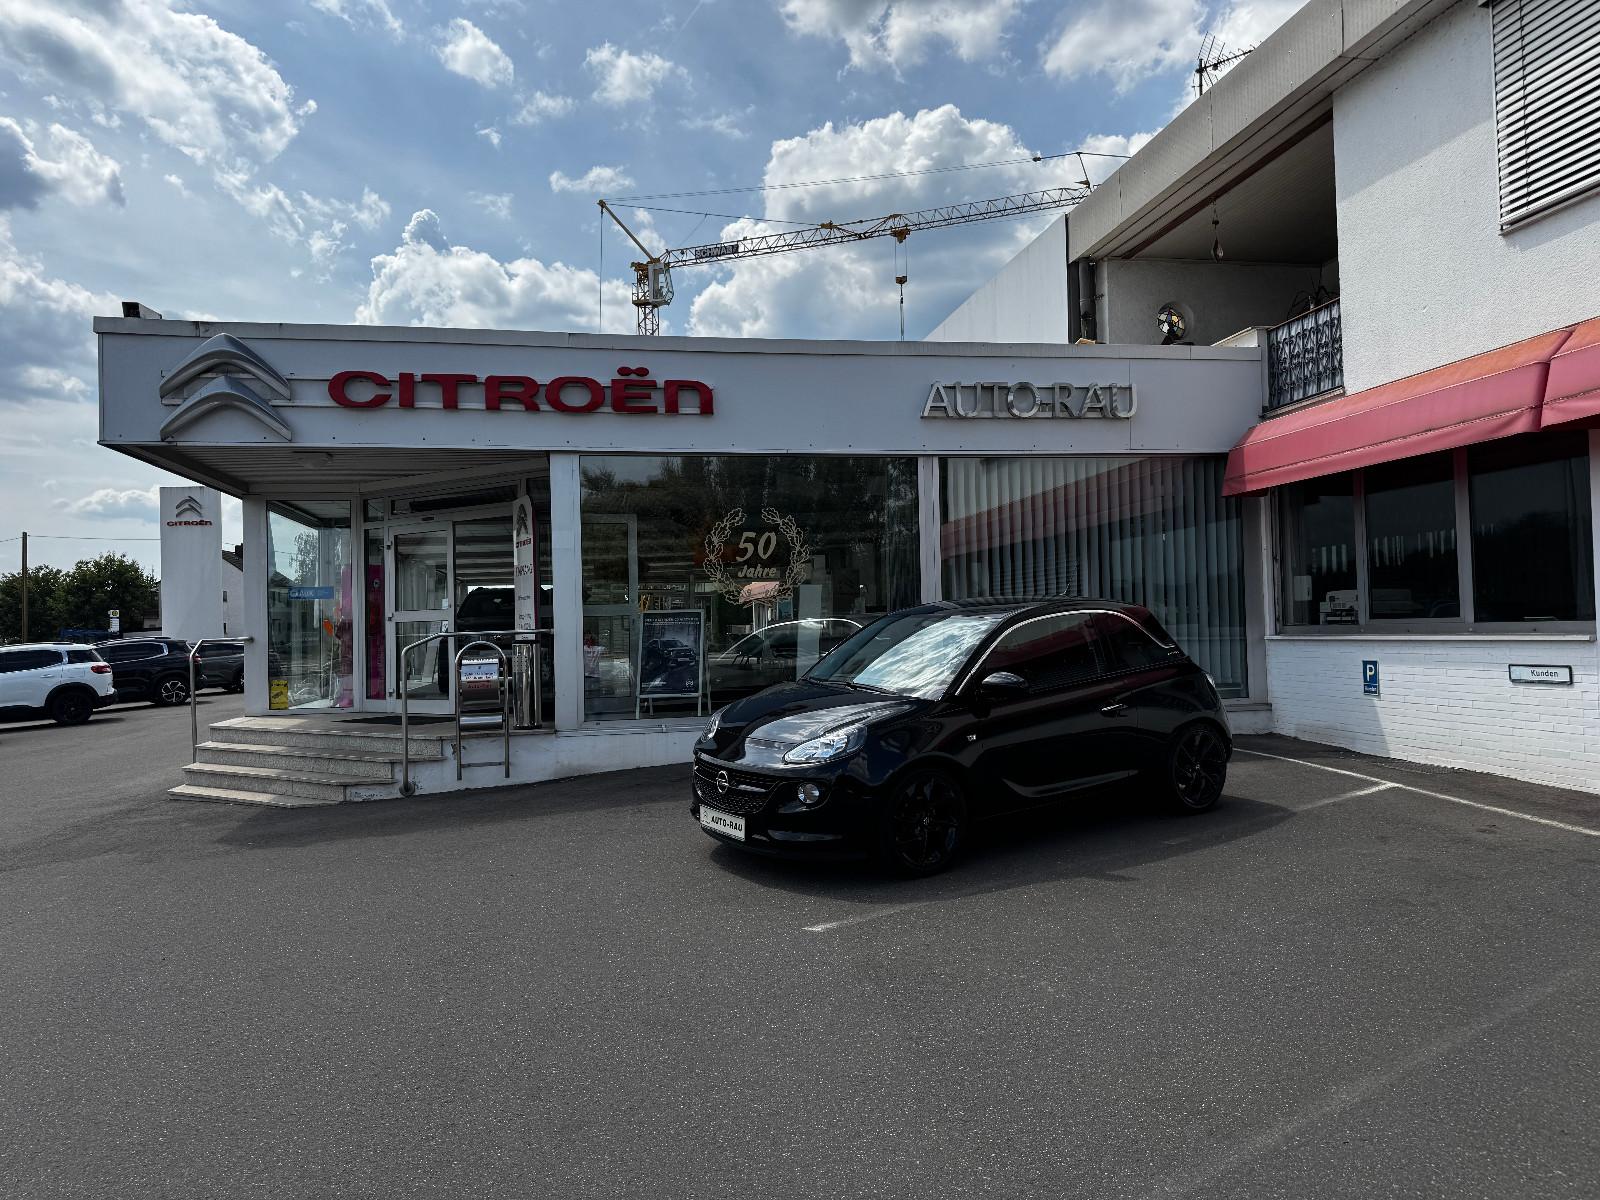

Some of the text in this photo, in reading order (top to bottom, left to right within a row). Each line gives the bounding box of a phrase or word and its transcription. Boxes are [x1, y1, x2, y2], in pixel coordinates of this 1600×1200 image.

[327, 366, 714, 415] CITROËN
[920, 381, 1138, 419] AUTO-RAU
[735, 531, 777, 562] 50
[737, 563, 777, 578] Jahre
[1366, 664, 1375, 682] P
[1530, 669, 1559, 677] Kunden
[711, 816, 743, 831] AUTO-RAU
